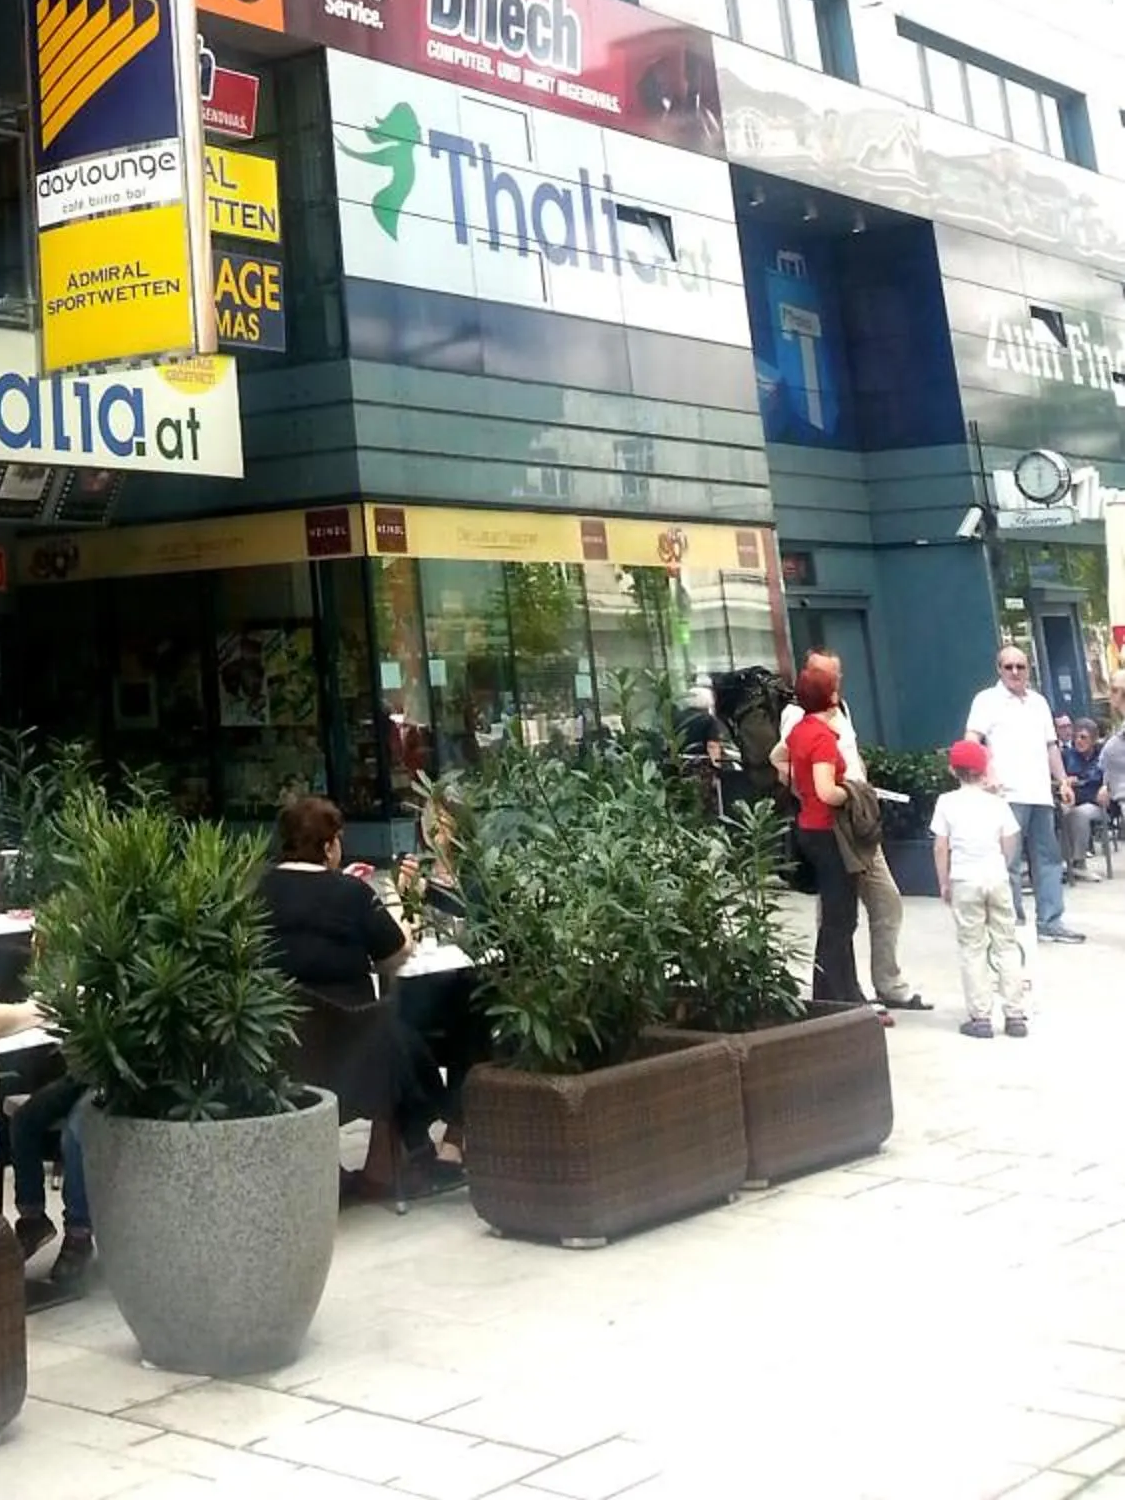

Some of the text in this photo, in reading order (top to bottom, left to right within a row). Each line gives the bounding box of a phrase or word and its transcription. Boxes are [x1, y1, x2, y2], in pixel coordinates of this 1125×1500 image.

[38, 152, 176, 199] daylounge
[46, 278, 181, 316] SPORTWETTEN
[66, 260, 150, 292] ADMIRAL
[215, 256, 281, 312] AGE
